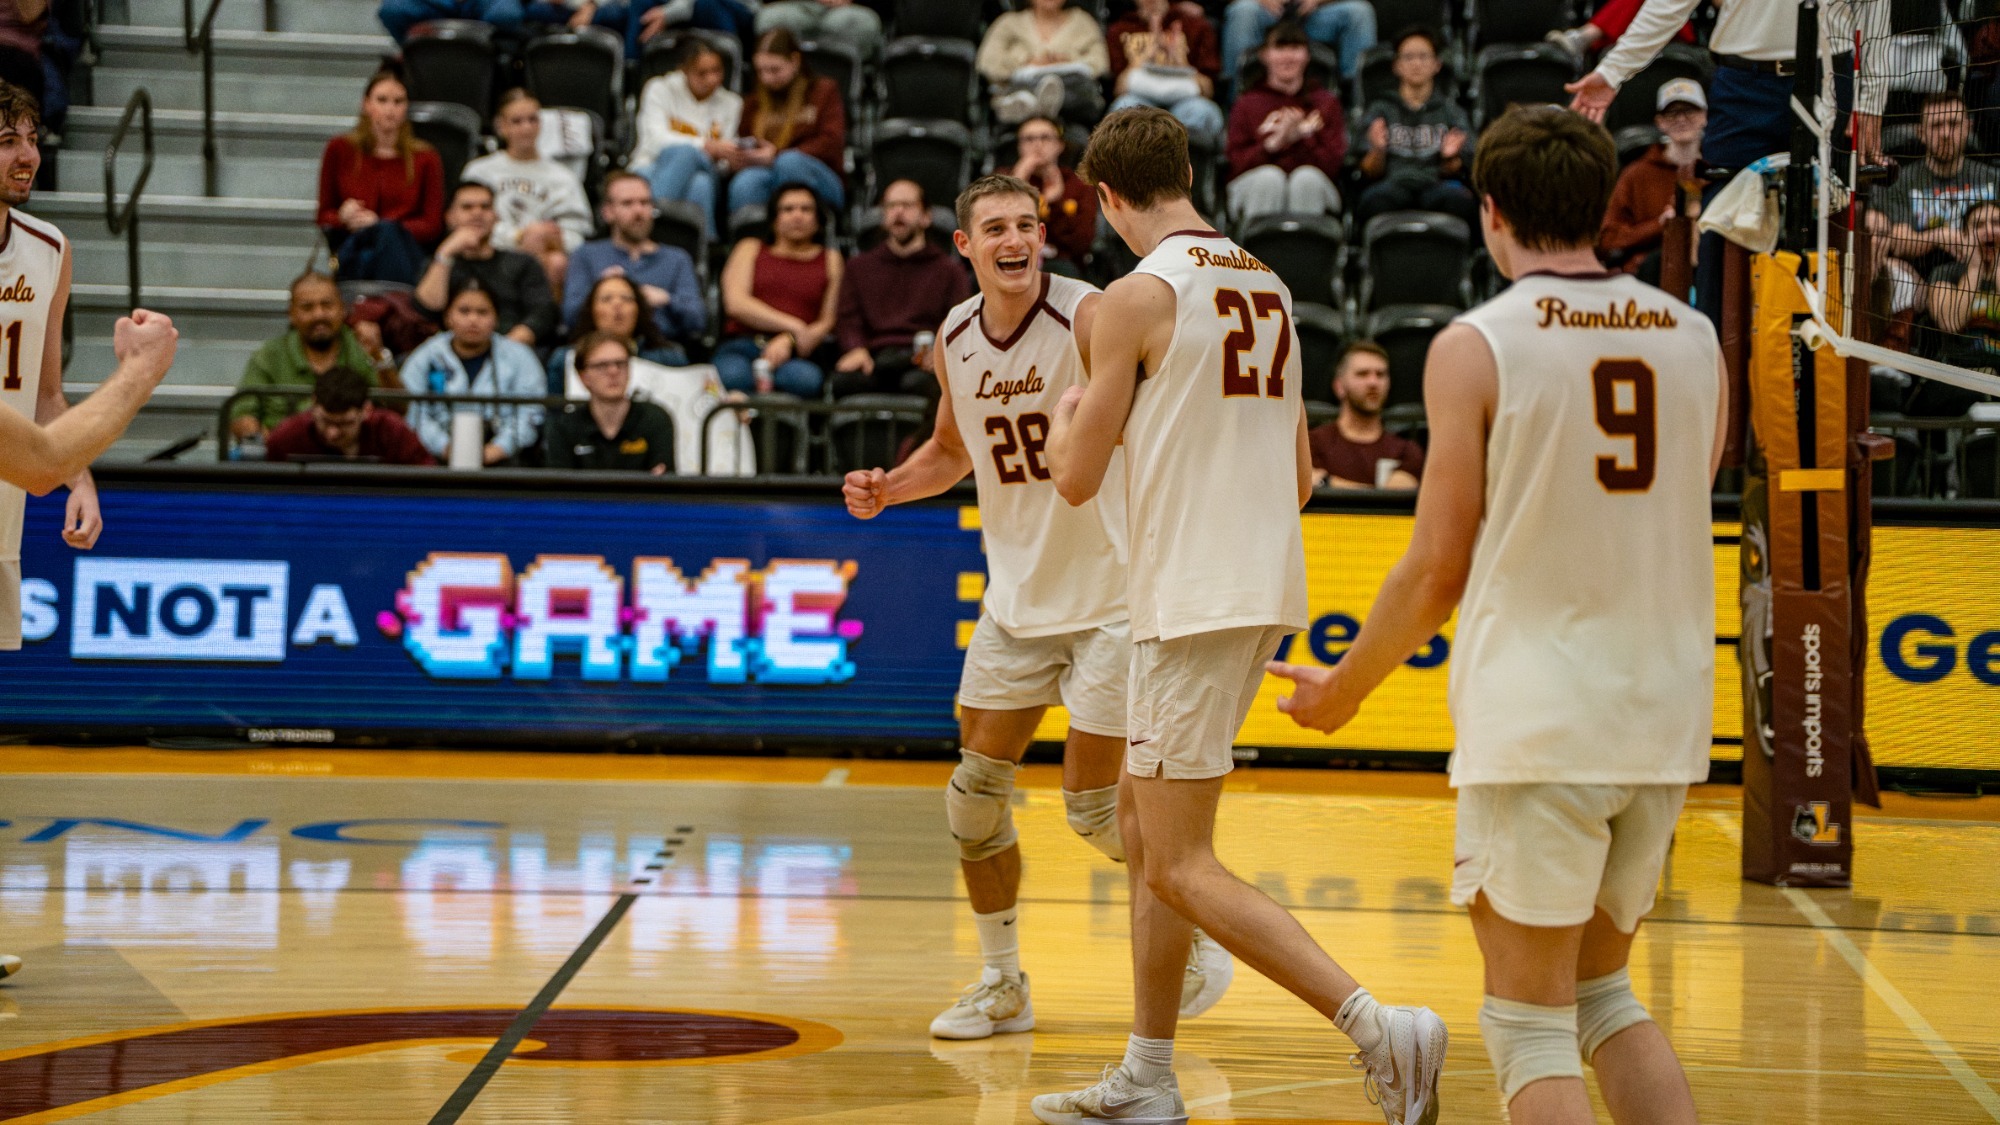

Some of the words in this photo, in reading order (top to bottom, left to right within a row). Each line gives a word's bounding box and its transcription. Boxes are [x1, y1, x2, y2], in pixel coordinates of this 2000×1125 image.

[0, 274, 35, 302] ola
[1535, 297, 1678, 330] Ramblers
[0, 320, 22, 391] 1
[1213, 287, 1291, 400] 27
[975, 365, 1045, 405] Loyola
[984, 411, 1052, 485] 28
[1591, 357, 1658, 495] 9
[93, 581, 271, 641] NOT
[291, 583, 360, 646] A
[396, 550, 856, 685] GAME
[1801, 623, 1823, 692] sports
[1802, 694, 1825, 778] imports
[1808, 801, 1841, 847] L
